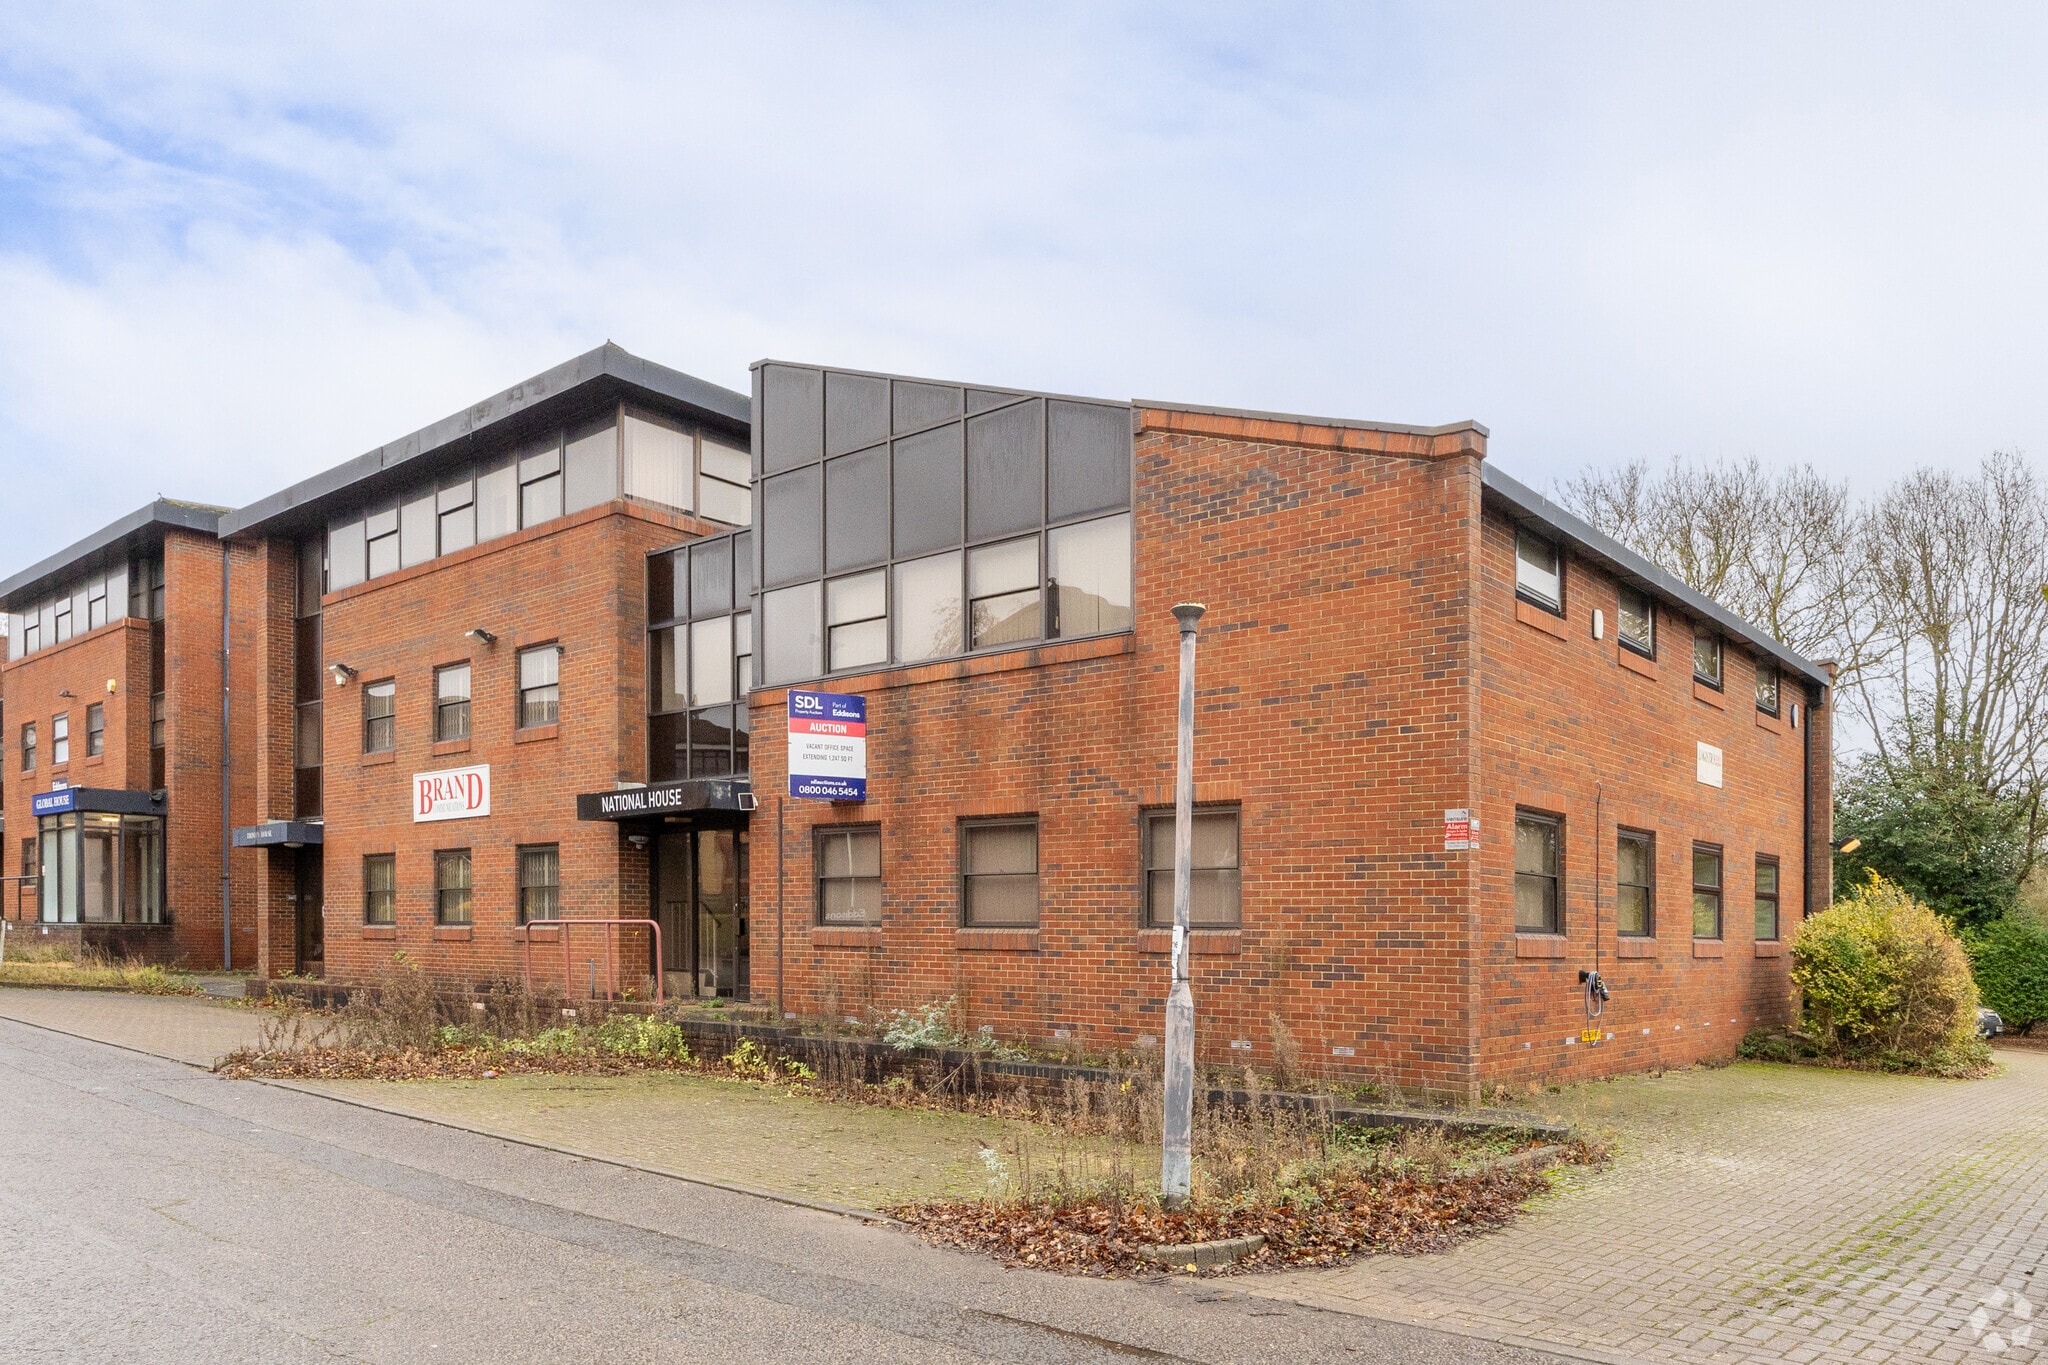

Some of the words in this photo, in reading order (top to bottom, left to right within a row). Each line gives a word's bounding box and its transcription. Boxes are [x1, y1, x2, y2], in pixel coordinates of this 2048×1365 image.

[795, 695, 823, 710] SDL
[832, 709, 860, 719] Eddisons
[809, 722, 847, 734] AUCTION
[802, 753, 827, 761] EXTENDING
[418, 773, 483, 815] BRAND
[798, 785, 821, 795] 0800
[822, 786, 837, 796] 046
[838, 787, 858, 797] 5454
[36, 797, 53, 809] GLOBAL
[53, 794, 70, 807] HOUSE
[601, 792, 647, 813] NATIONAL
[648, 788, 682, 808] HOUSE
